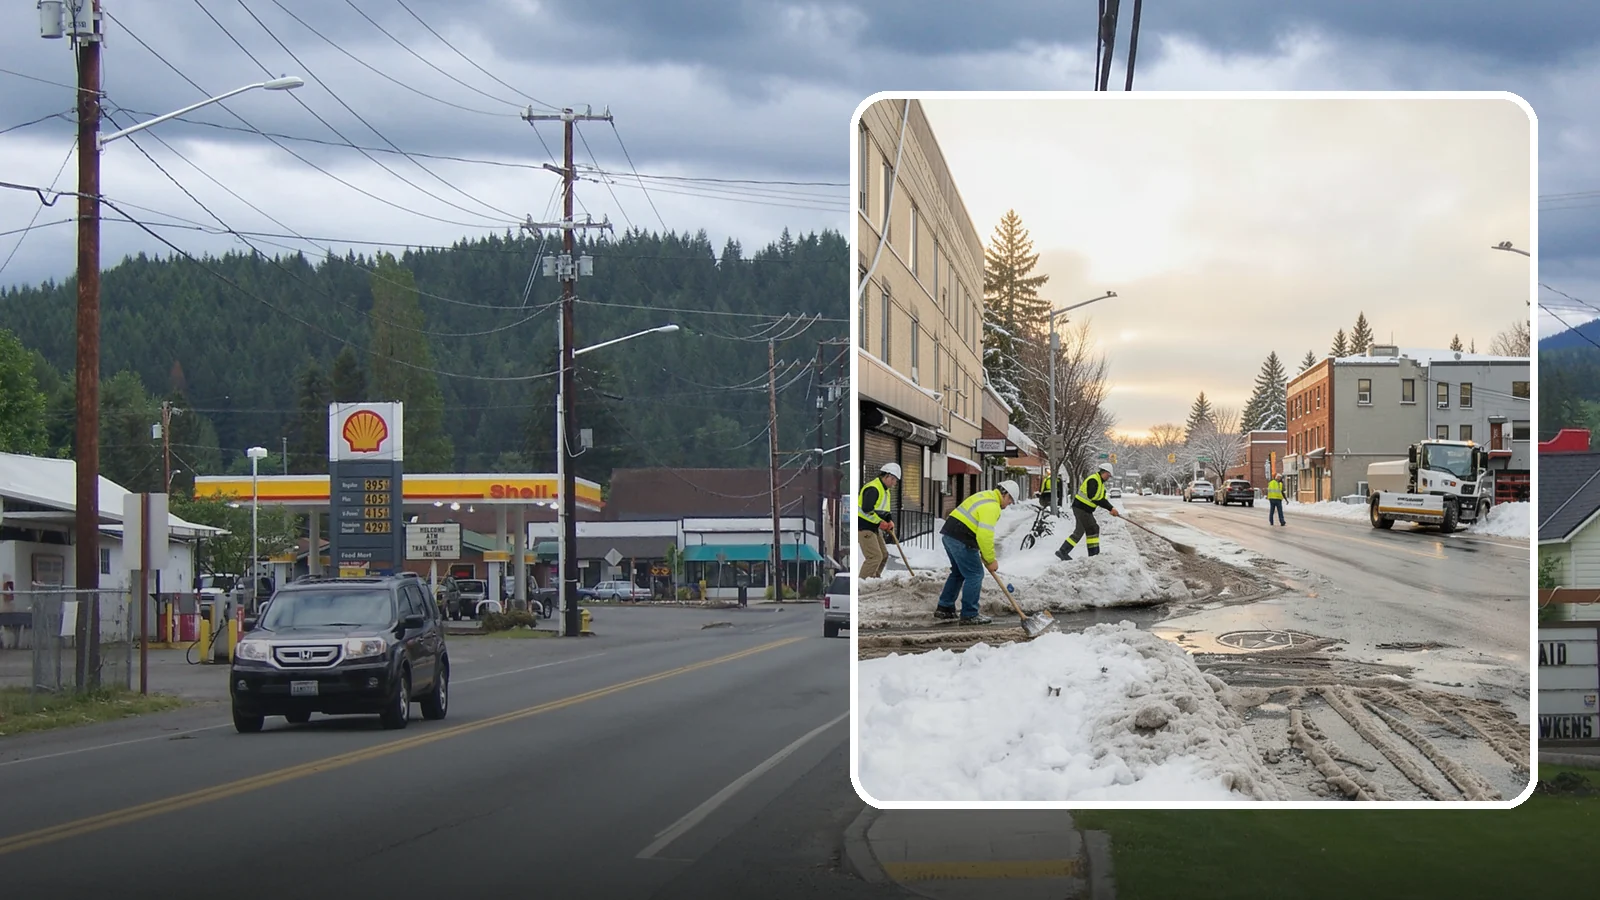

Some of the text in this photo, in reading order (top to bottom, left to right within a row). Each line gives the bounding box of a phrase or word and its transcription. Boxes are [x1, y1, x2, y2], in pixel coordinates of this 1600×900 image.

[366, 480, 383, 490] 395
[490, 484, 547, 498] Shell
[366, 495, 383, 504] 405
[366, 508, 383, 518] 415
[366, 522, 383, 533] 429
[1539, 643, 1567, 665] AID
